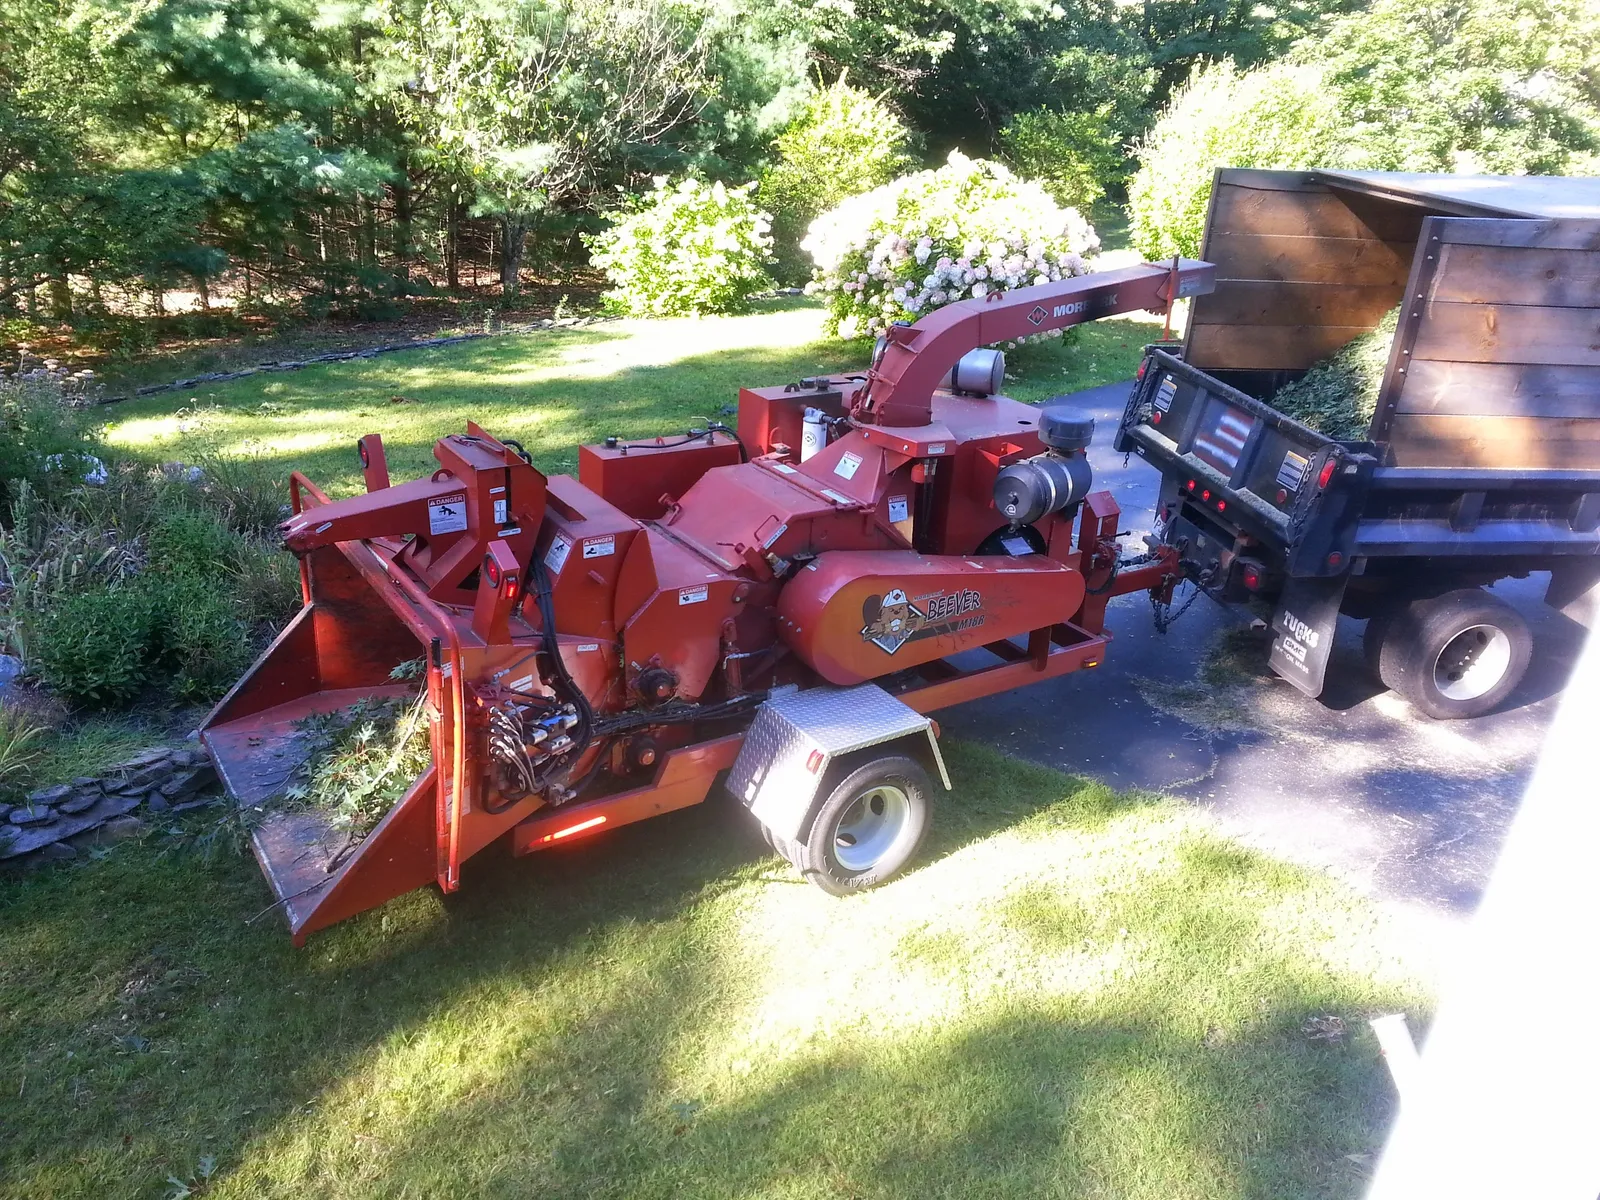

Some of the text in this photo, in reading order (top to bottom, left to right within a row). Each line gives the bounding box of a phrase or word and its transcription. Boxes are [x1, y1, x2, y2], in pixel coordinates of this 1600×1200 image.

[1053, 293, 1118, 318] MORRK
[435, 495, 464, 506] DANGER
[589, 536, 613, 545] DANGER
[685, 586, 707, 595] DANGER
[926, 588, 981, 622] BEEVER
[1283, 610, 1320, 648] TUCKS
[1285, 639, 1305, 657] GMC
